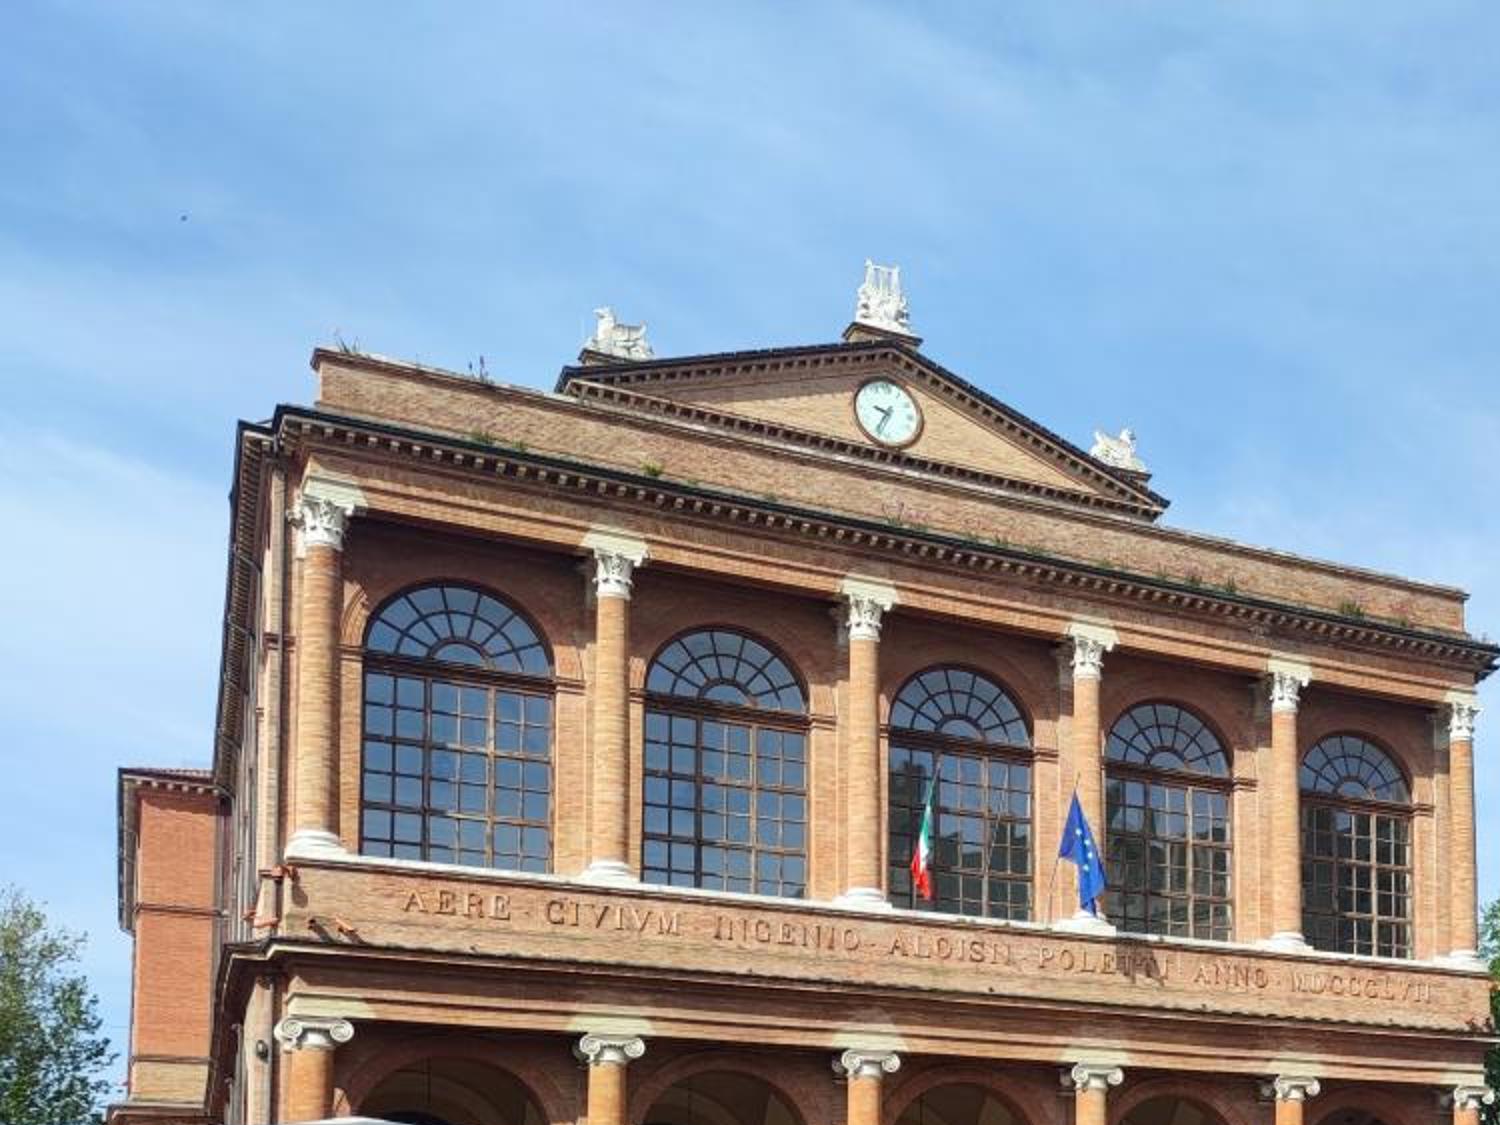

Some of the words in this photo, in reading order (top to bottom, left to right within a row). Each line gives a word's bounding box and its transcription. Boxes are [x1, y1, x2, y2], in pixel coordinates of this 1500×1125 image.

[402, 889, 511, 921] AERE
[546, 899, 681, 936] CIVIVM
[712, 915, 860, 950] INGENIO
[1194, 963, 1269, 989] ANNO
